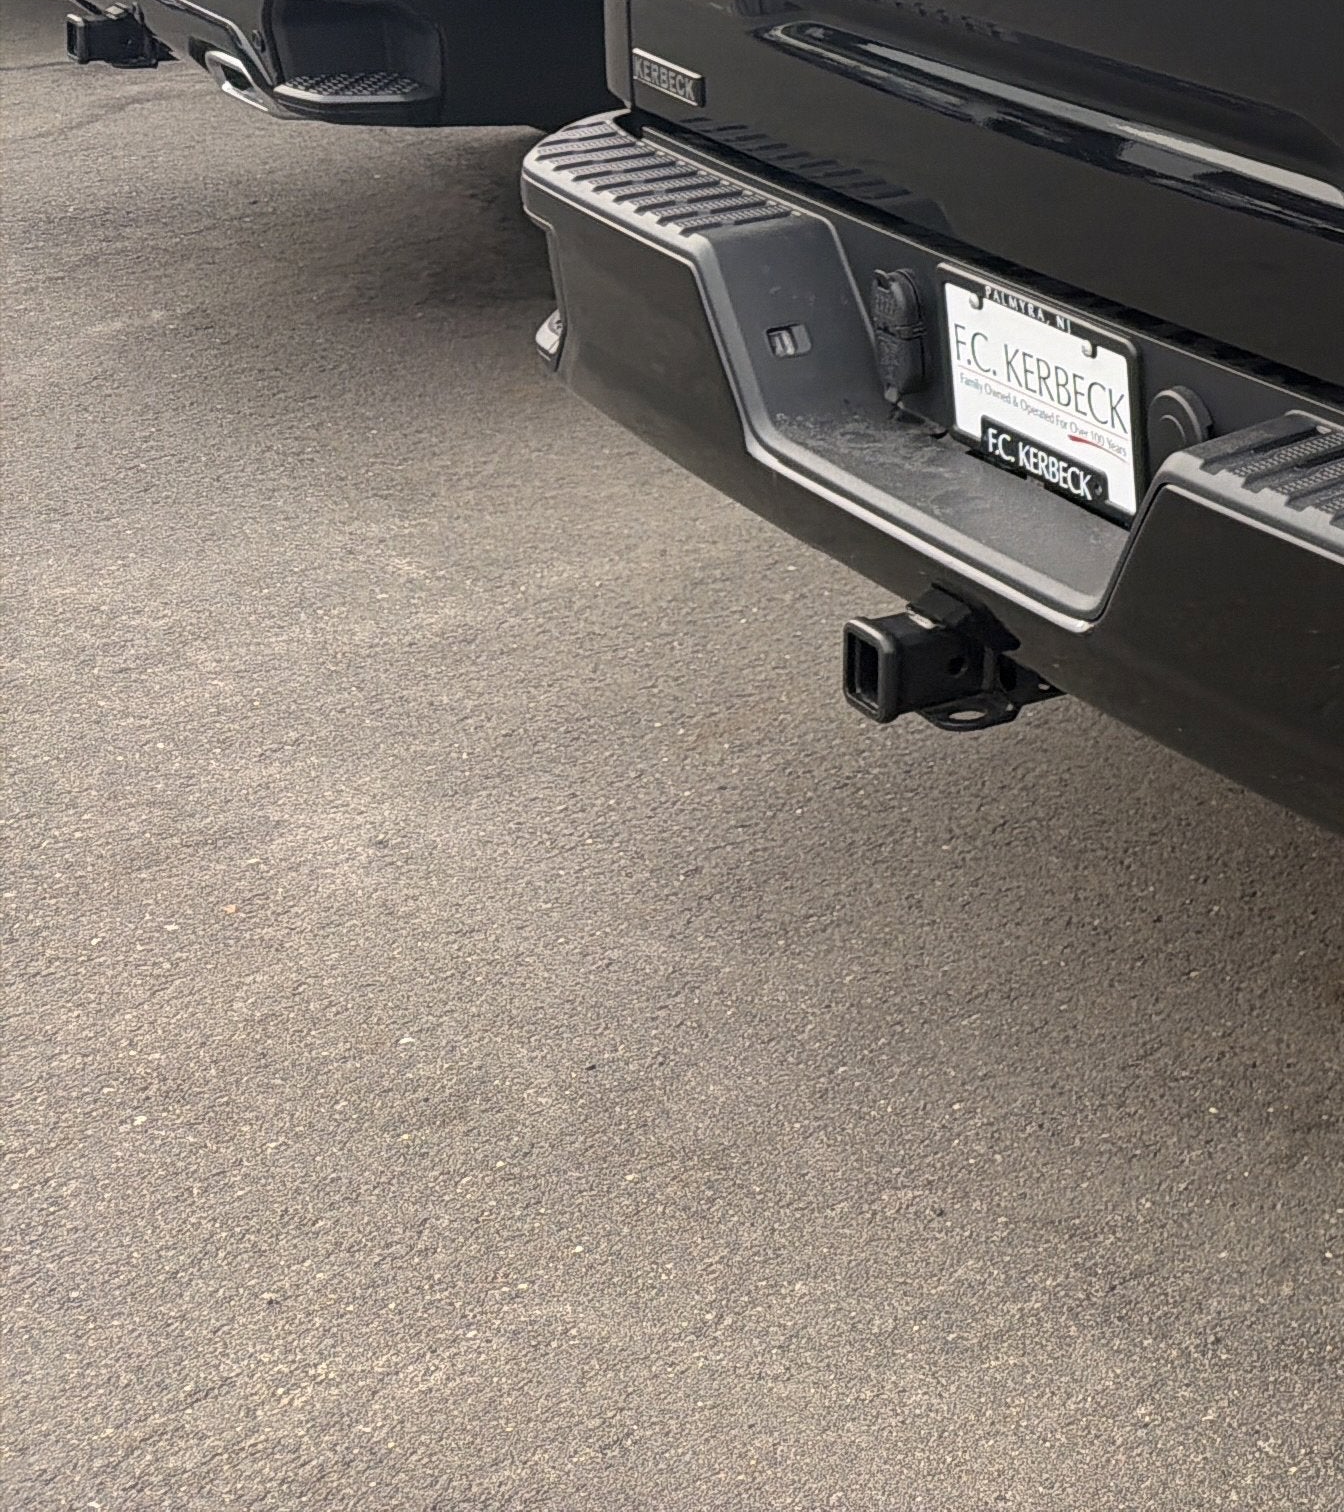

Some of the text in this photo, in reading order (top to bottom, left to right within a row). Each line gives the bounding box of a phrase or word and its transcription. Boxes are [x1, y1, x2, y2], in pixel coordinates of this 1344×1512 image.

[633, 55, 696, 101] KERBECK
[984, 285, 1072, 334] PALMYRA, NJ
[953, 323, 1128, 434] F.C. KERBECK
[960, 372, 983, 395] Family
[984, 383, 1012, 405] Owned
[1020, 399, 1055, 425] Operated
[1056, 414, 1068, 430] For
[1070, 421, 1088, 437] Over
[1091, 430, 1105, 447] 100
[1107, 437, 1127, 457] Years
[986, 427, 1093, 501] F.C. KERBECK
